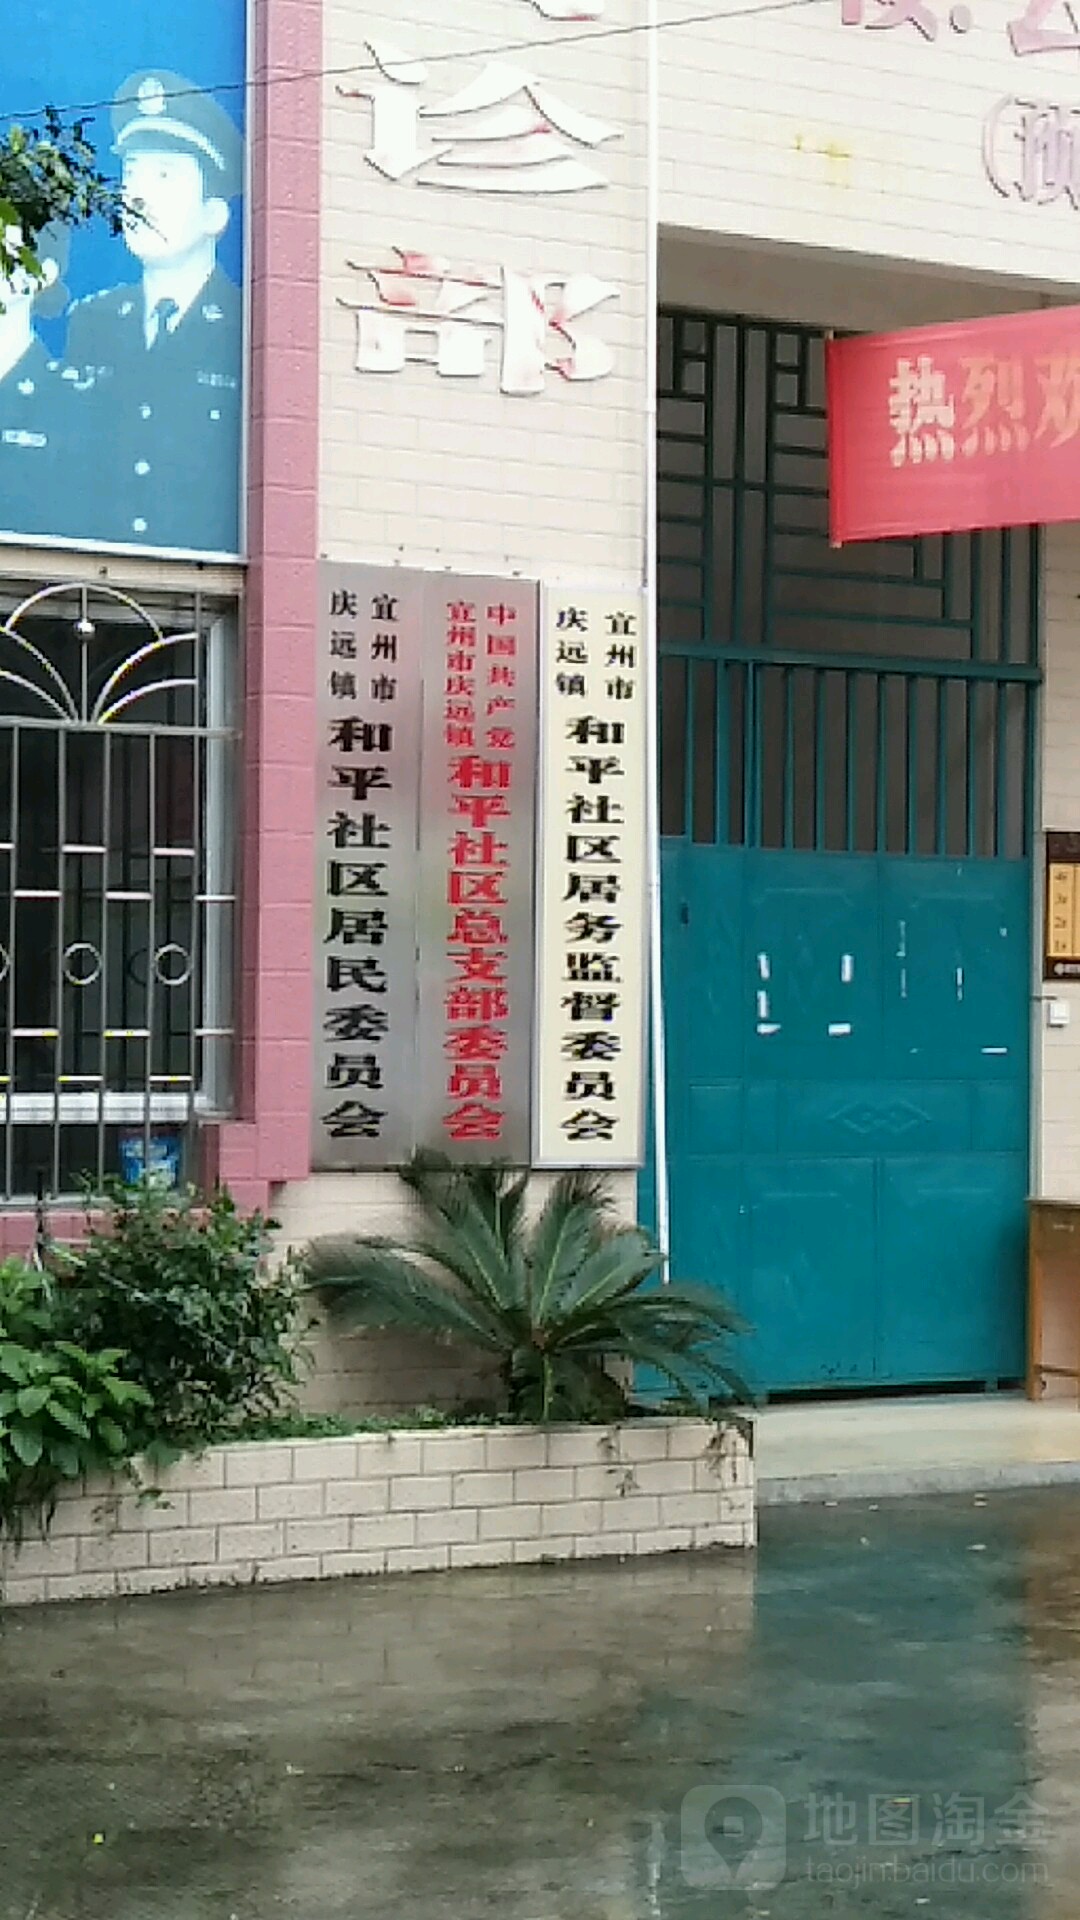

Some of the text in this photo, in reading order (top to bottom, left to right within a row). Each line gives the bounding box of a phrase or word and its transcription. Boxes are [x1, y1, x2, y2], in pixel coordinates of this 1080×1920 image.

[328, 589, 358, 700] 庆远镇
[371, 593, 398, 703] 宜州市
[443, 600, 476, 748] 宜州市庆远镇
[486, 602, 517, 749] 中国共产党
[556, 606, 589, 698] 庆远镇
[605, 610, 637, 700] 宜州市
[322, 715, 394, 1139] 和平社区居民委员会
[442, 755, 512, 1141] 和平社区总支部委员会
[560, 715, 625, 1141] 和平社区居务监督委员会
